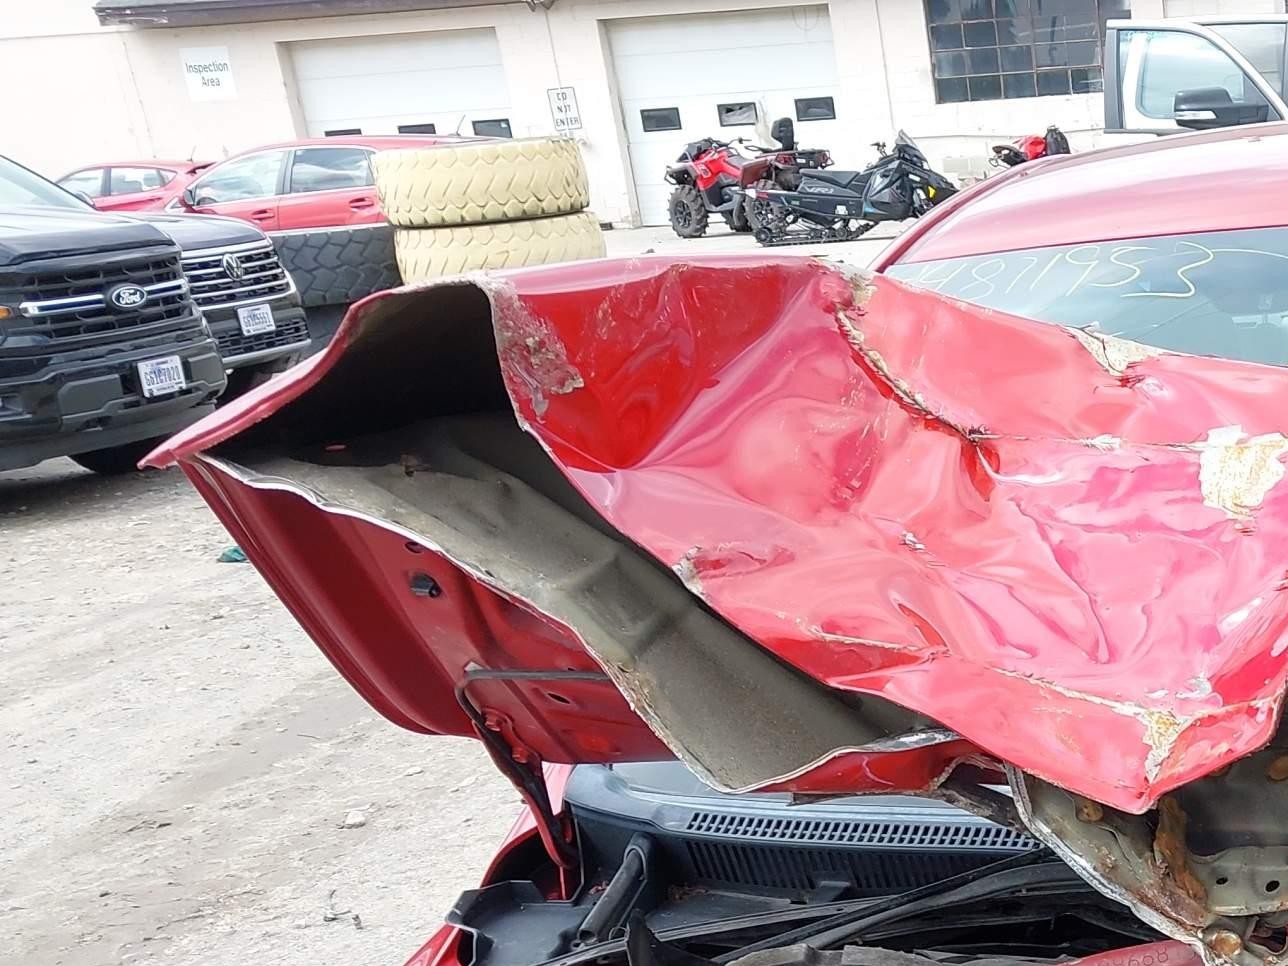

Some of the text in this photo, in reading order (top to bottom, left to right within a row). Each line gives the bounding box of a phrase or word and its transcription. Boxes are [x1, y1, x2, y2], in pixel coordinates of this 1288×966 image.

[184, 60, 229, 76] Inspection
[201, 76, 221, 87] Area
[119, 289, 142, 305] Ford
